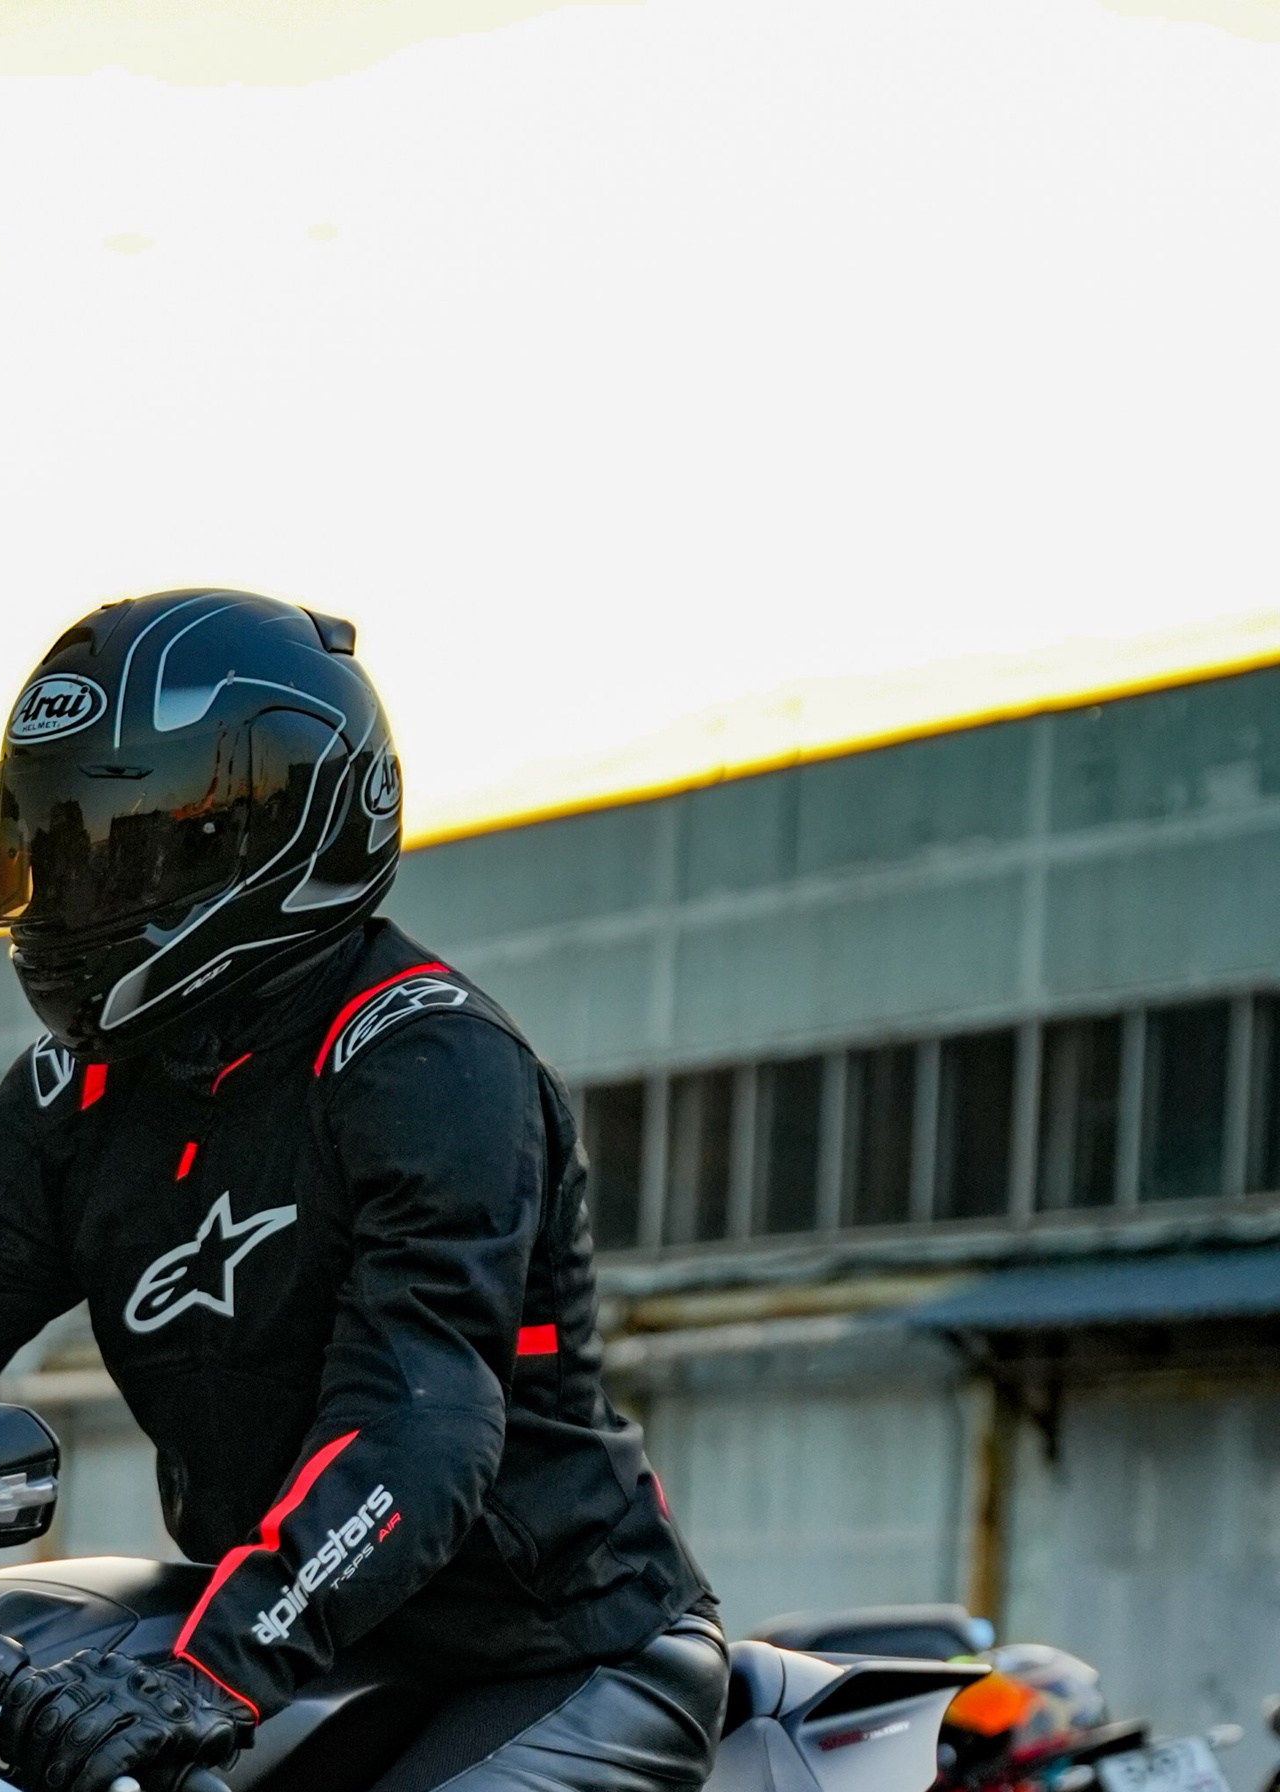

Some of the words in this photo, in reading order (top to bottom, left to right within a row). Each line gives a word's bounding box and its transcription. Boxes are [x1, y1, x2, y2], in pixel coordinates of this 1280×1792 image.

[12, 685, 90, 725] Arai
[22, 720, 58, 732] HELMET
[251, 1483, 395, 1646] alpinestars
[330, 1545, 374, 1590] T-SPS
[378, 1511, 403, 1543] AIR
